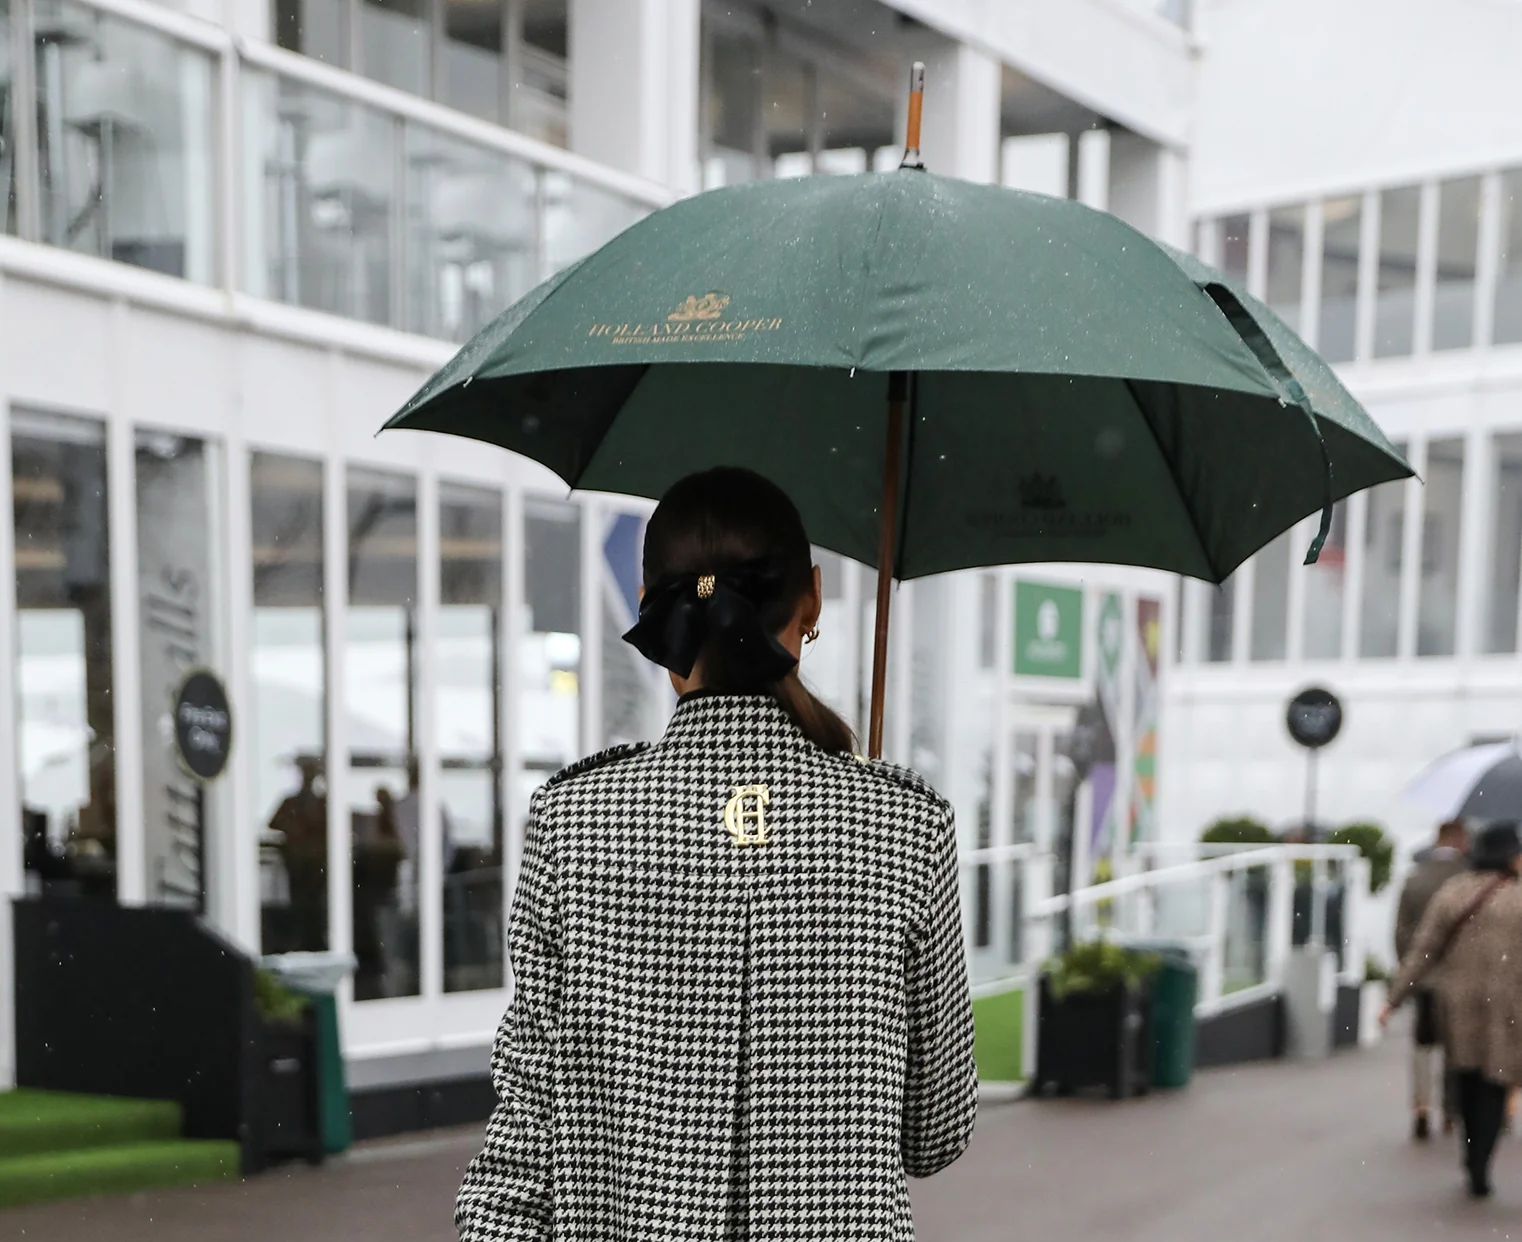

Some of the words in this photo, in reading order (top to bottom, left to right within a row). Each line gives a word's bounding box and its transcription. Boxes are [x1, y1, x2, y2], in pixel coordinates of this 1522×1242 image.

[588, 323, 691, 336] HOLLAND
[695, 317, 782, 333] COOPER
[144, 562, 201, 908] Tattalls
